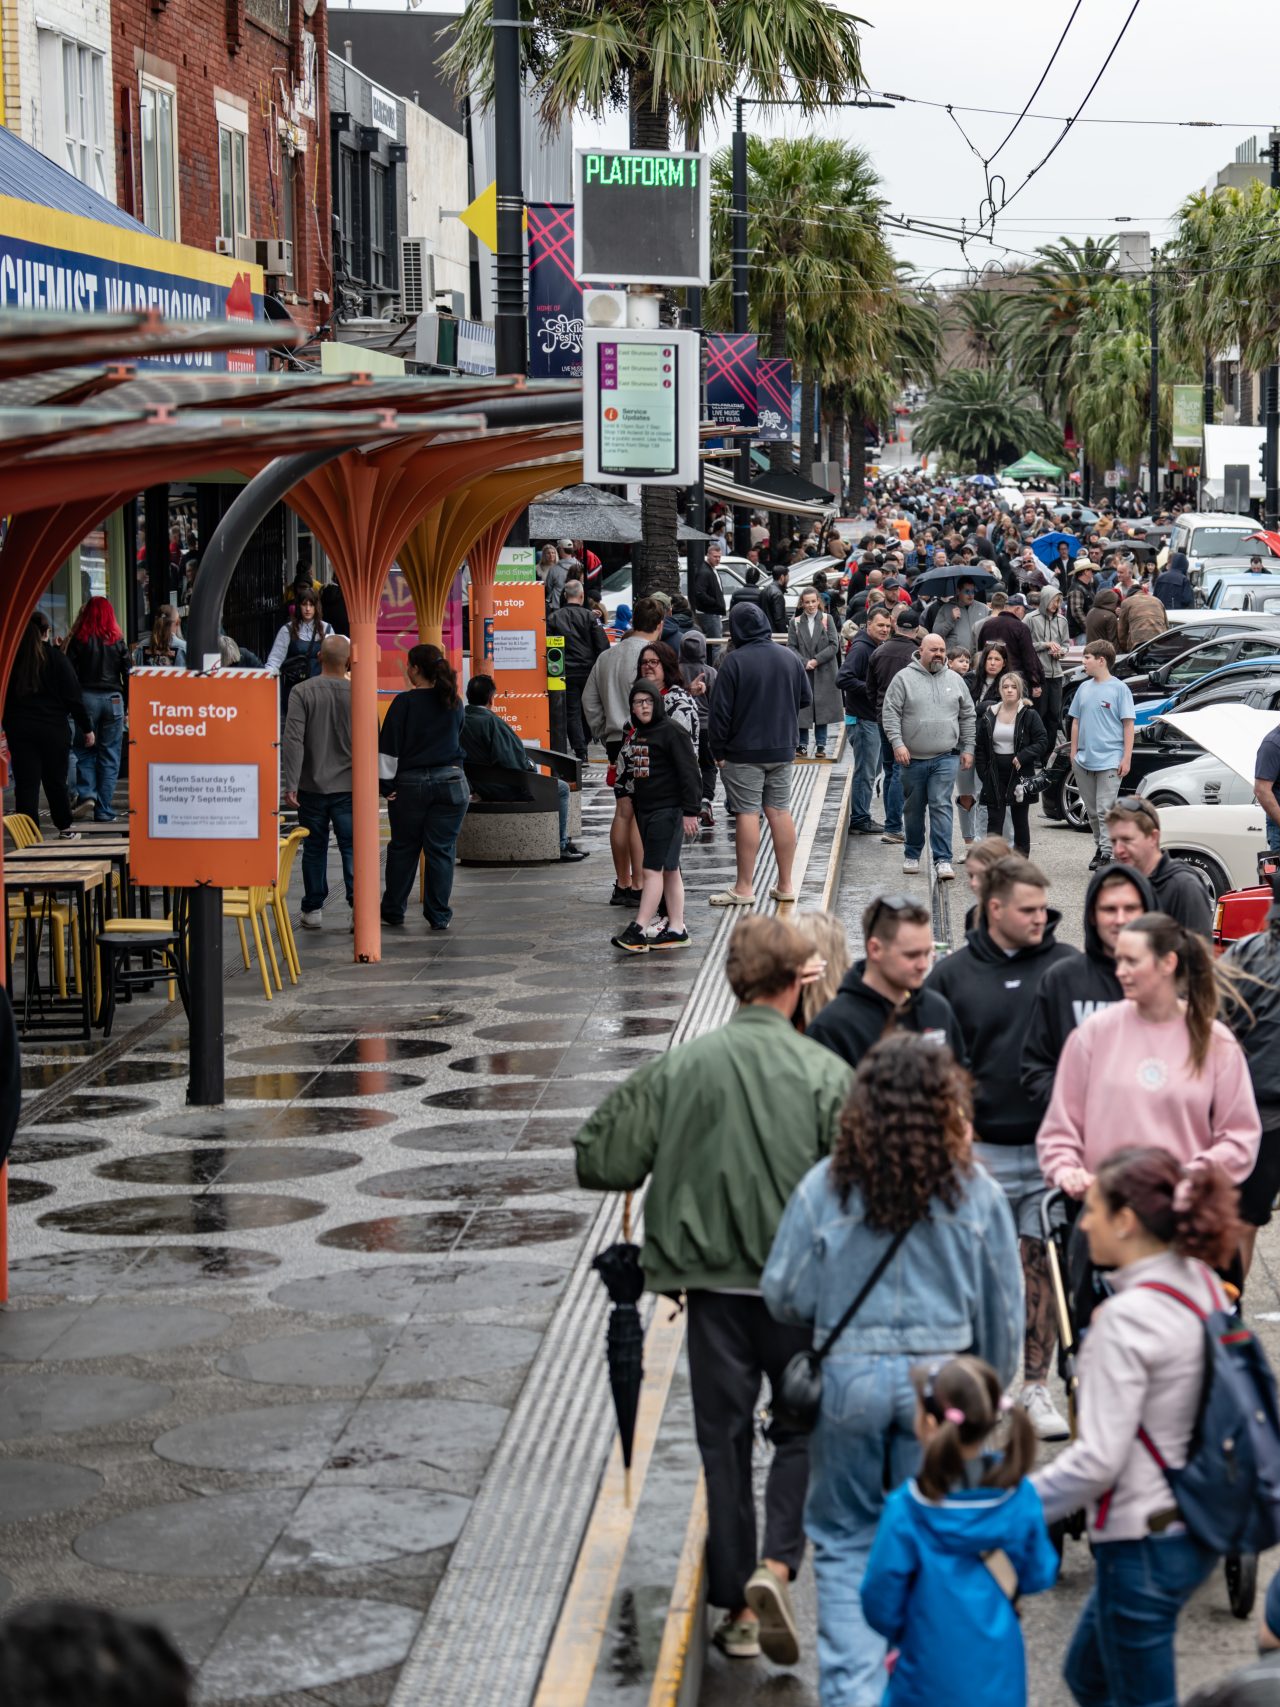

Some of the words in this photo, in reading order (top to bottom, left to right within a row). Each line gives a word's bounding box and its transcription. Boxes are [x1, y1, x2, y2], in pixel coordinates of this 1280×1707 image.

[586, 155, 684, 187] PLATFORM
[690, 159, 697, 187] 1
[0, 254, 97, 314] CHEMIST
[512, 568, 533, 576] Street
[504, 600, 525, 610] stop
[149, 701, 193, 717] Tram
[198, 704, 238, 722] stop
[149, 721, 207, 736] closed
[158, 776, 189, 784] 4.45pm
[191, 776, 227, 784] Saturday
[158, 785, 203, 793] September
[216, 786, 246, 794] 8.15pm
[158, 795, 188, 804] Sunday
[191, 795, 195, 803] 7
[197, 795, 243, 804] September
